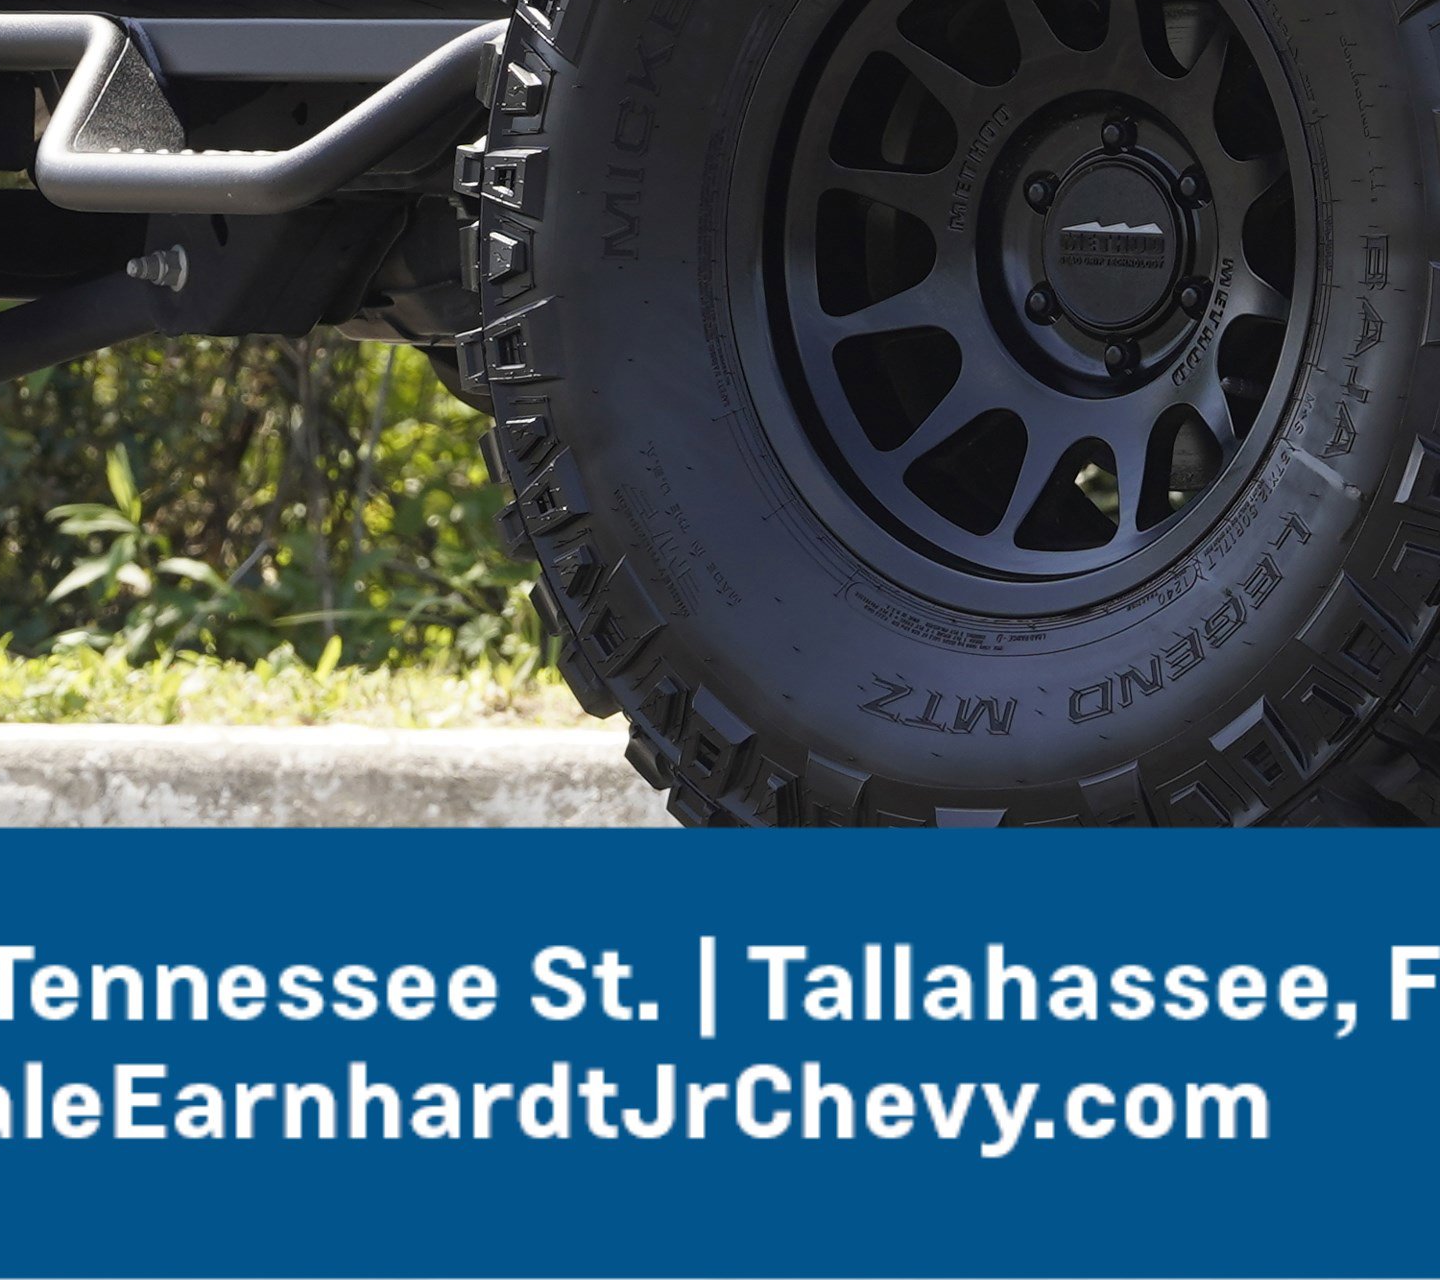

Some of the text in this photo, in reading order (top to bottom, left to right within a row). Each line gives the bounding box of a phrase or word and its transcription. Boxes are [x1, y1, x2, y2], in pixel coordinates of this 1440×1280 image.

[947, 104, 1011, 232] METHOD
[1170, 256, 1235, 387] METHOD
[857, 233, 1391, 737] BAJA LEGEND MTZ
